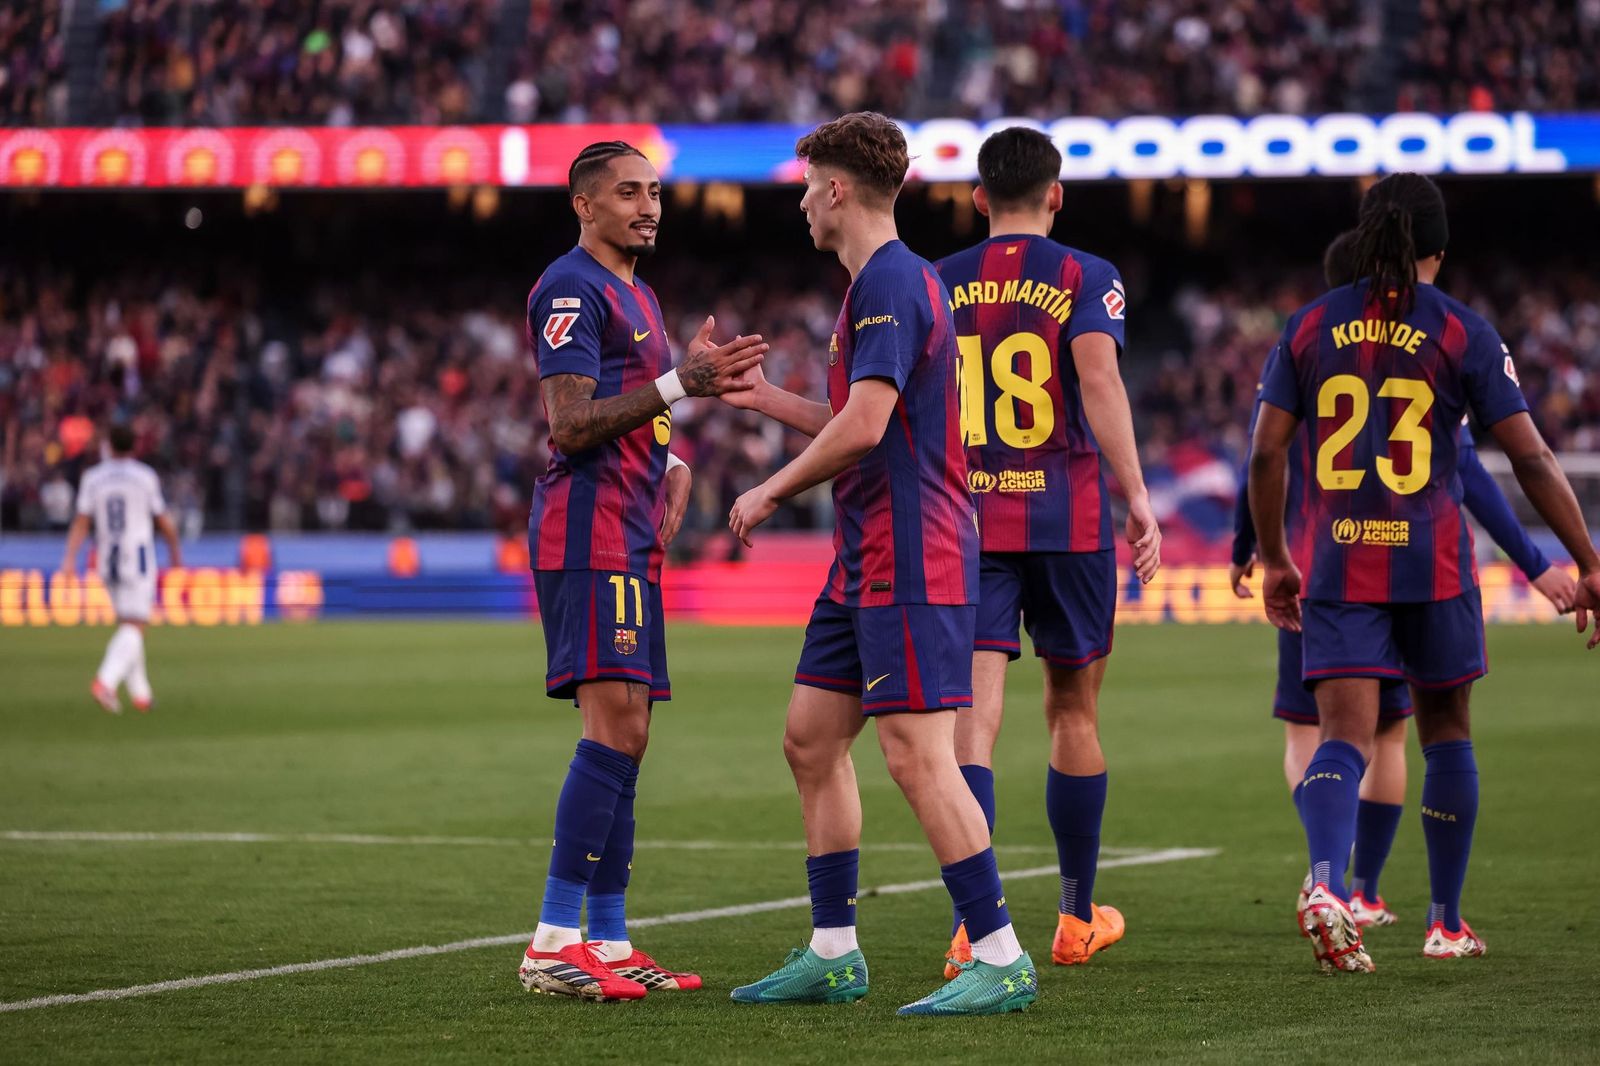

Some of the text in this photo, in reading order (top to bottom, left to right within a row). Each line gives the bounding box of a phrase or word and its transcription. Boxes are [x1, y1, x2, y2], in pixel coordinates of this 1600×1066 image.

[948, 279, 1073, 325] ARD MARTÍN
[1331, 319, 1427, 355] KOUNDE
[956, 332, 1055, 449] 18
[1316, 374, 1435, 495] 23
[998, 479, 1046, 489] ACNUR
[999, 470, 1045, 480] UNHCR
[1362, 530, 1409, 541] ACNUR
[1363, 520, 1409, 531] UNHCR
[608, 575, 643, 627] 11
